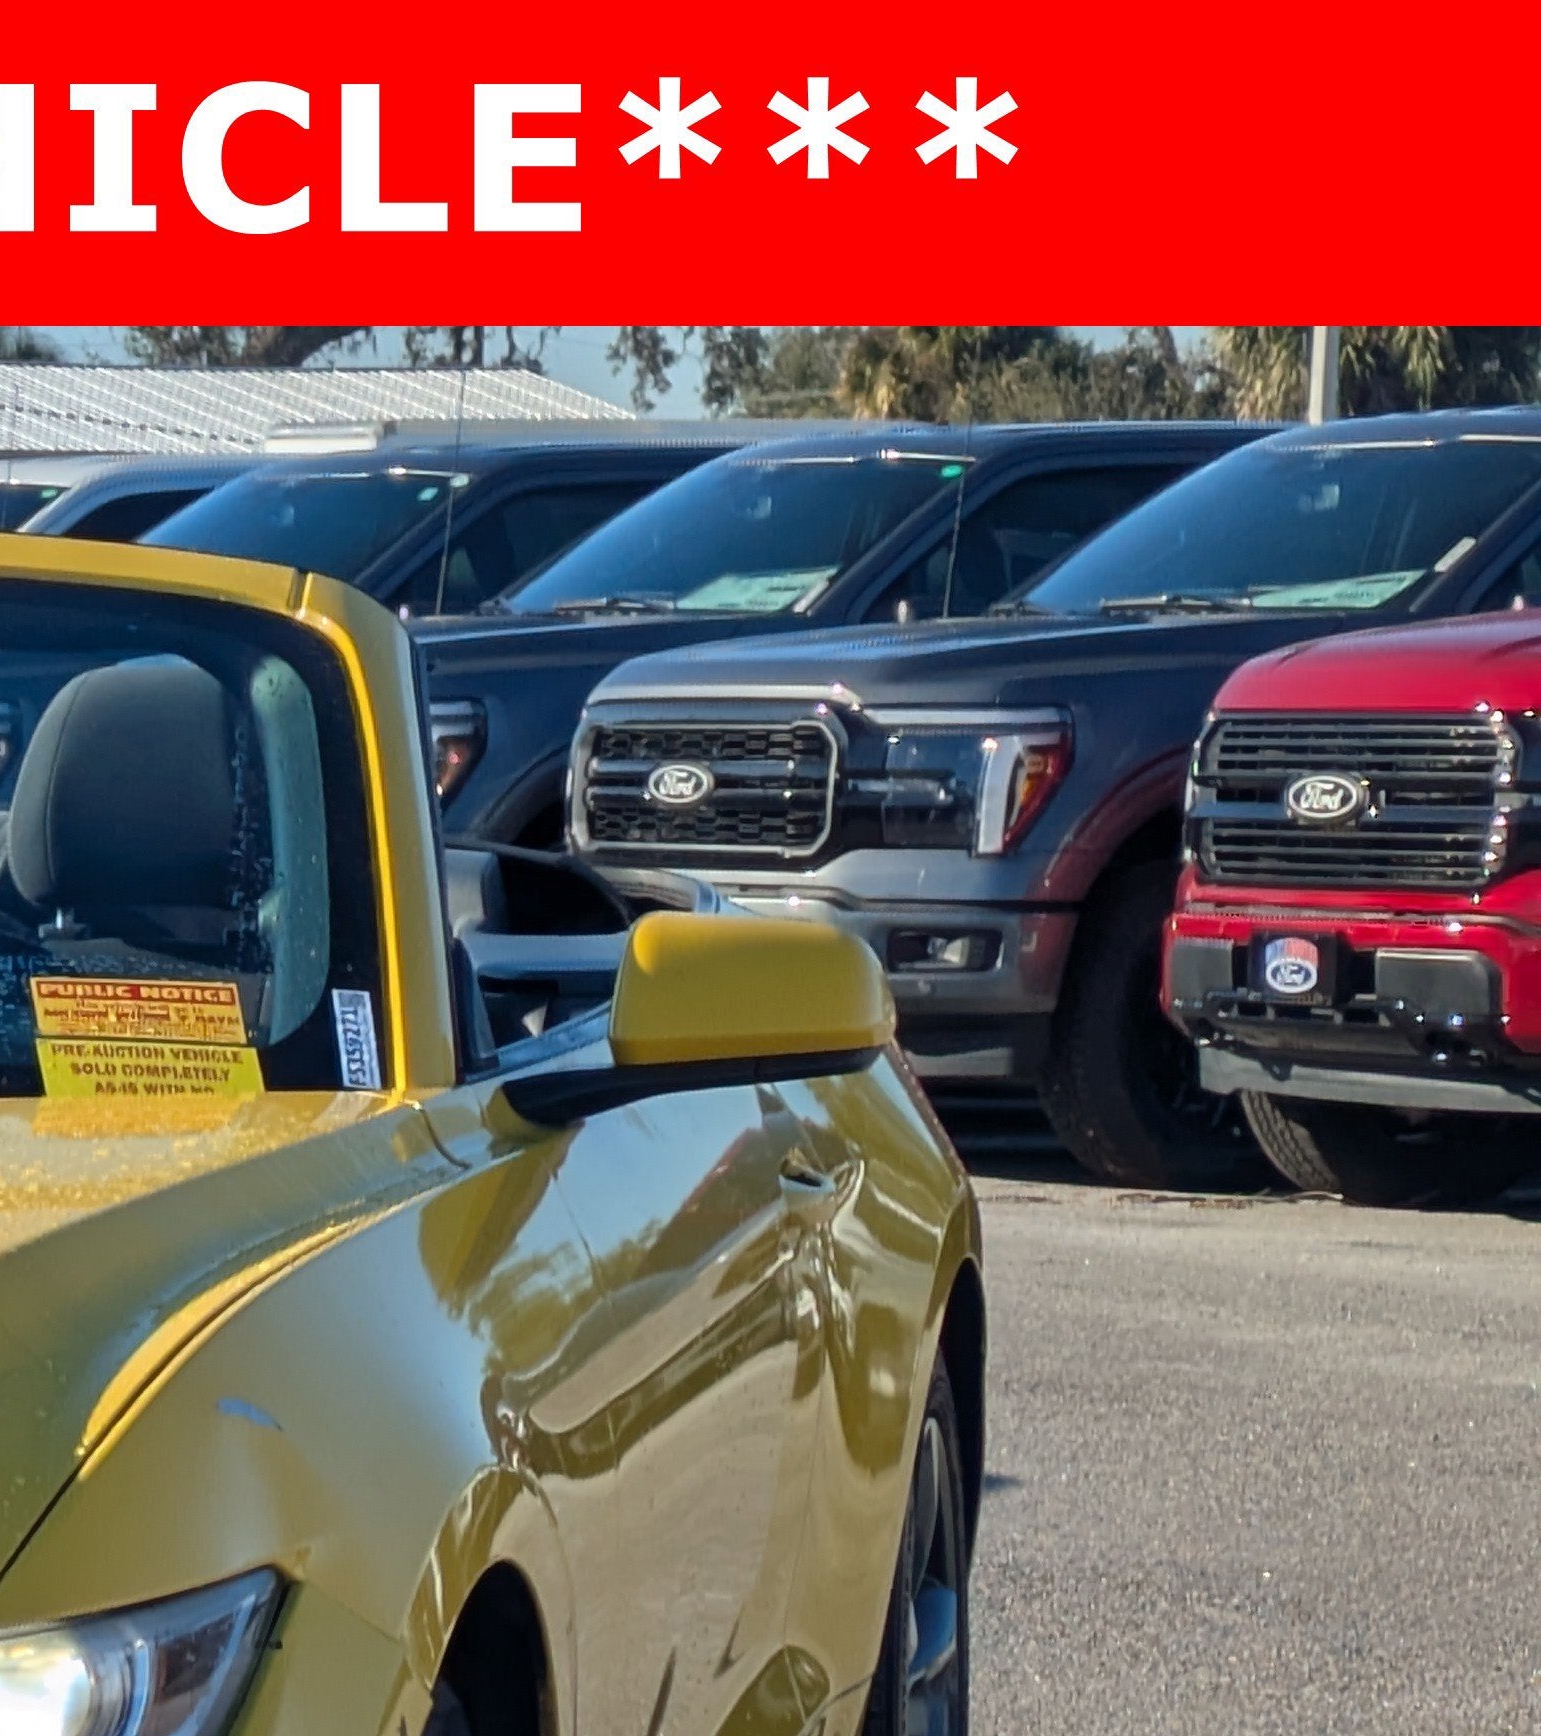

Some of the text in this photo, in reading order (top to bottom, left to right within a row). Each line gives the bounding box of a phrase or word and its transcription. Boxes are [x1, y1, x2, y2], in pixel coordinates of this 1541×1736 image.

[39, 983, 234, 1003] PUBLIC NOTICE
[51, 1043, 244, 1065] PRE-AUCTION VEHICLE
[69, 1062, 230, 1082] SOLD COMPLETELY
